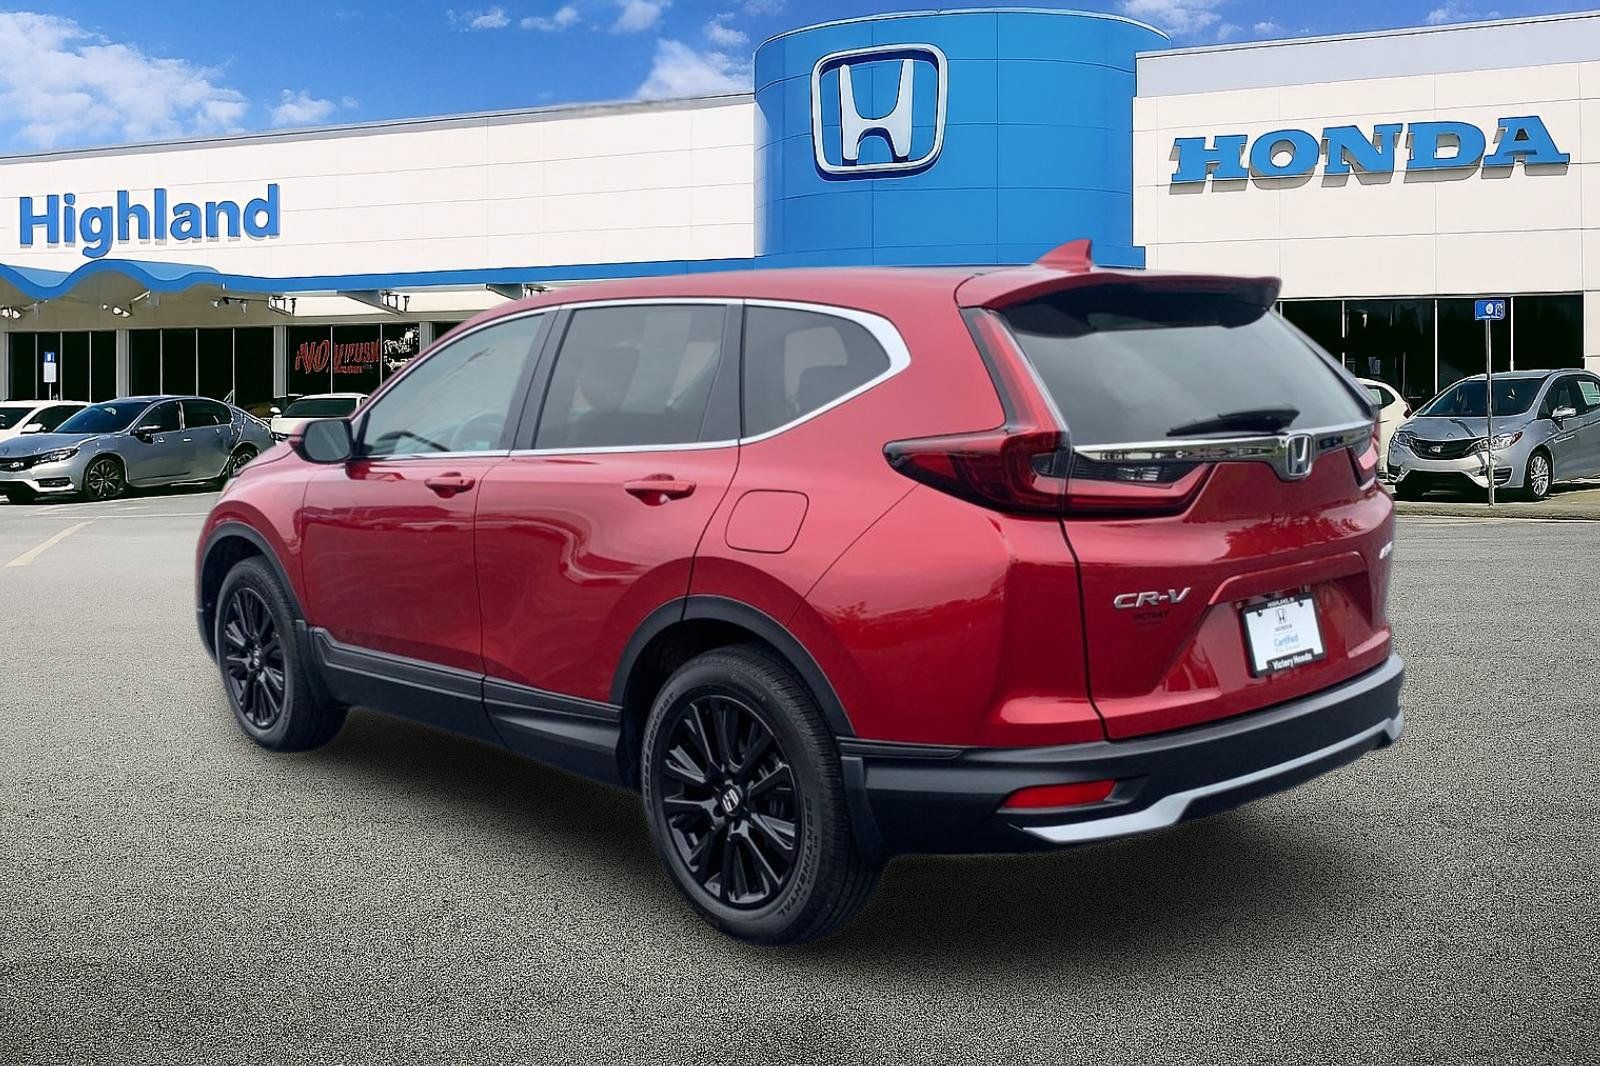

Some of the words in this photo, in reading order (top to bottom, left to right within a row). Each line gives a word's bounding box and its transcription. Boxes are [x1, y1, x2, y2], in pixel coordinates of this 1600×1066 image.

[1170, 114, 1571, 184] HONDA
[19, 183, 281, 258] Highland
[1113, 586, 1192, 609] CR-V
[1272, 658, 1294, 670] Victory
[1293, 652, 1313, 664] Honda
